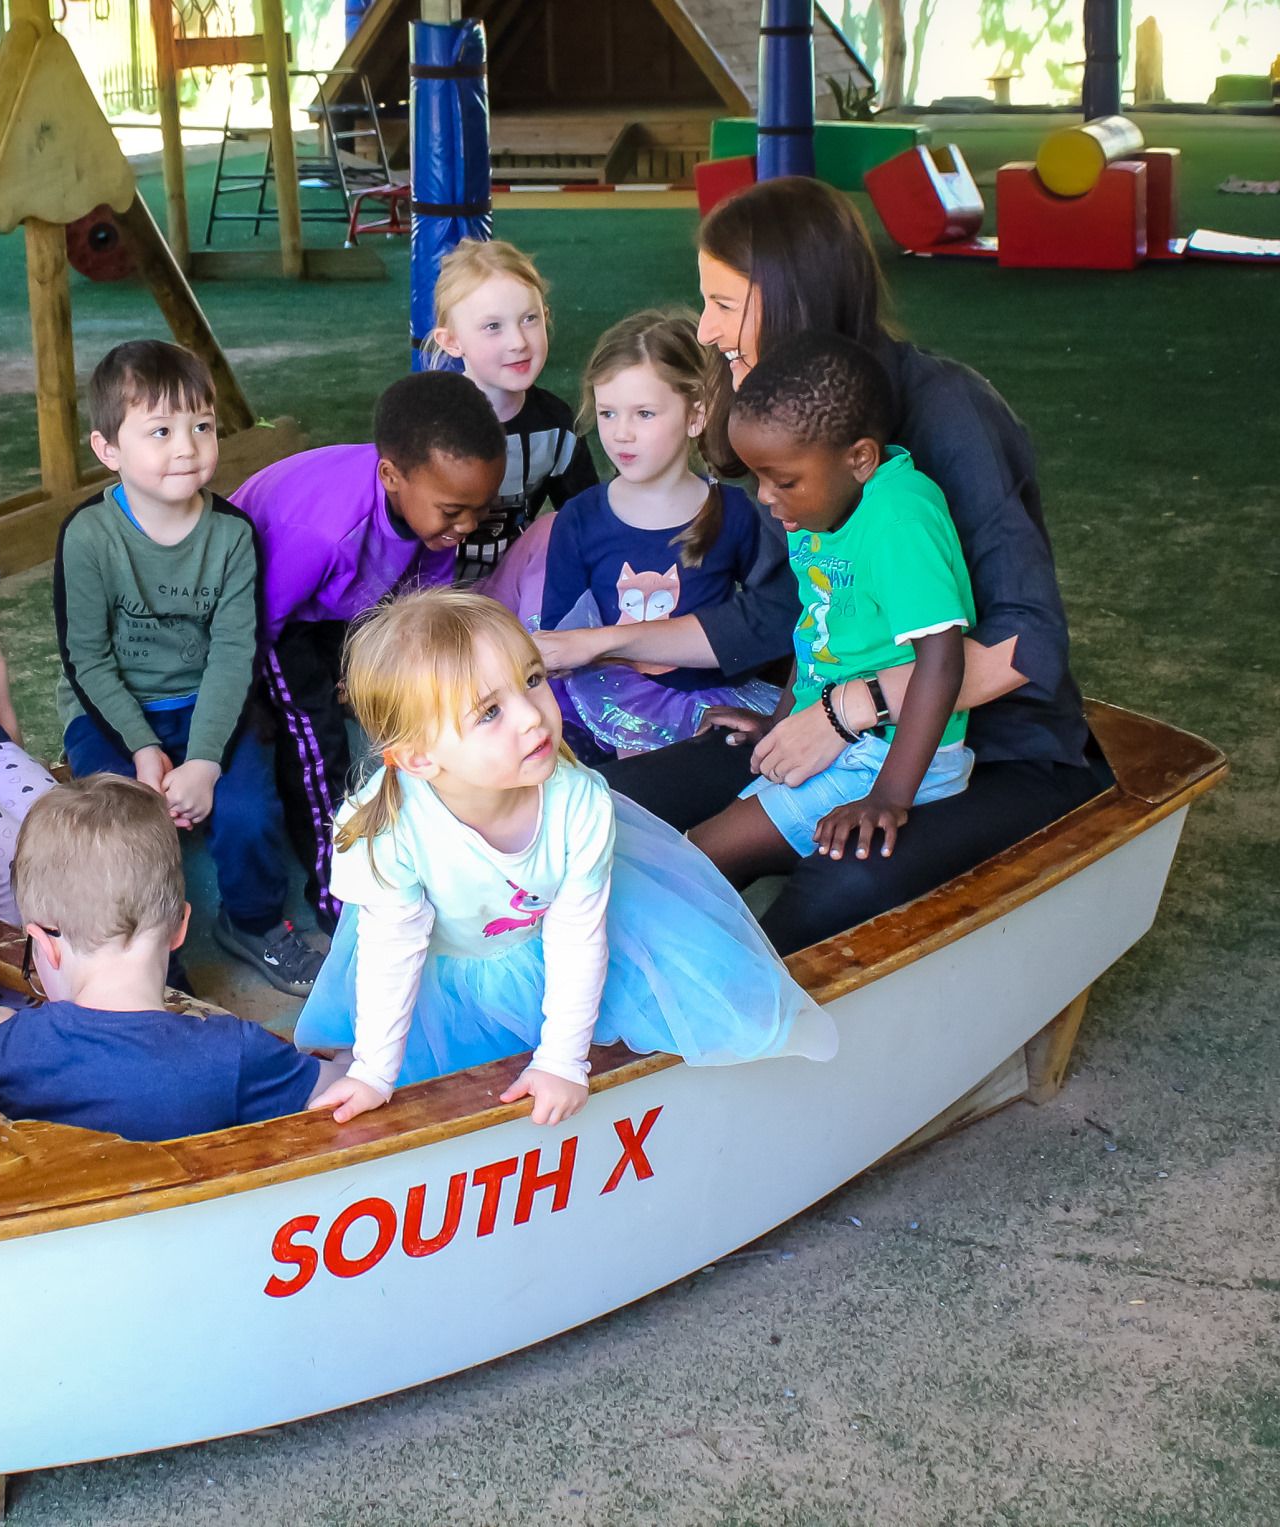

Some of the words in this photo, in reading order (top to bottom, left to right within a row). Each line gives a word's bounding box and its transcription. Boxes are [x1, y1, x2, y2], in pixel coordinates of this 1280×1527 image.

[195, 601, 210, 611] TH
[263, 1135, 578, 1298] SOUTH
[600, 1105, 664, 1196] X
